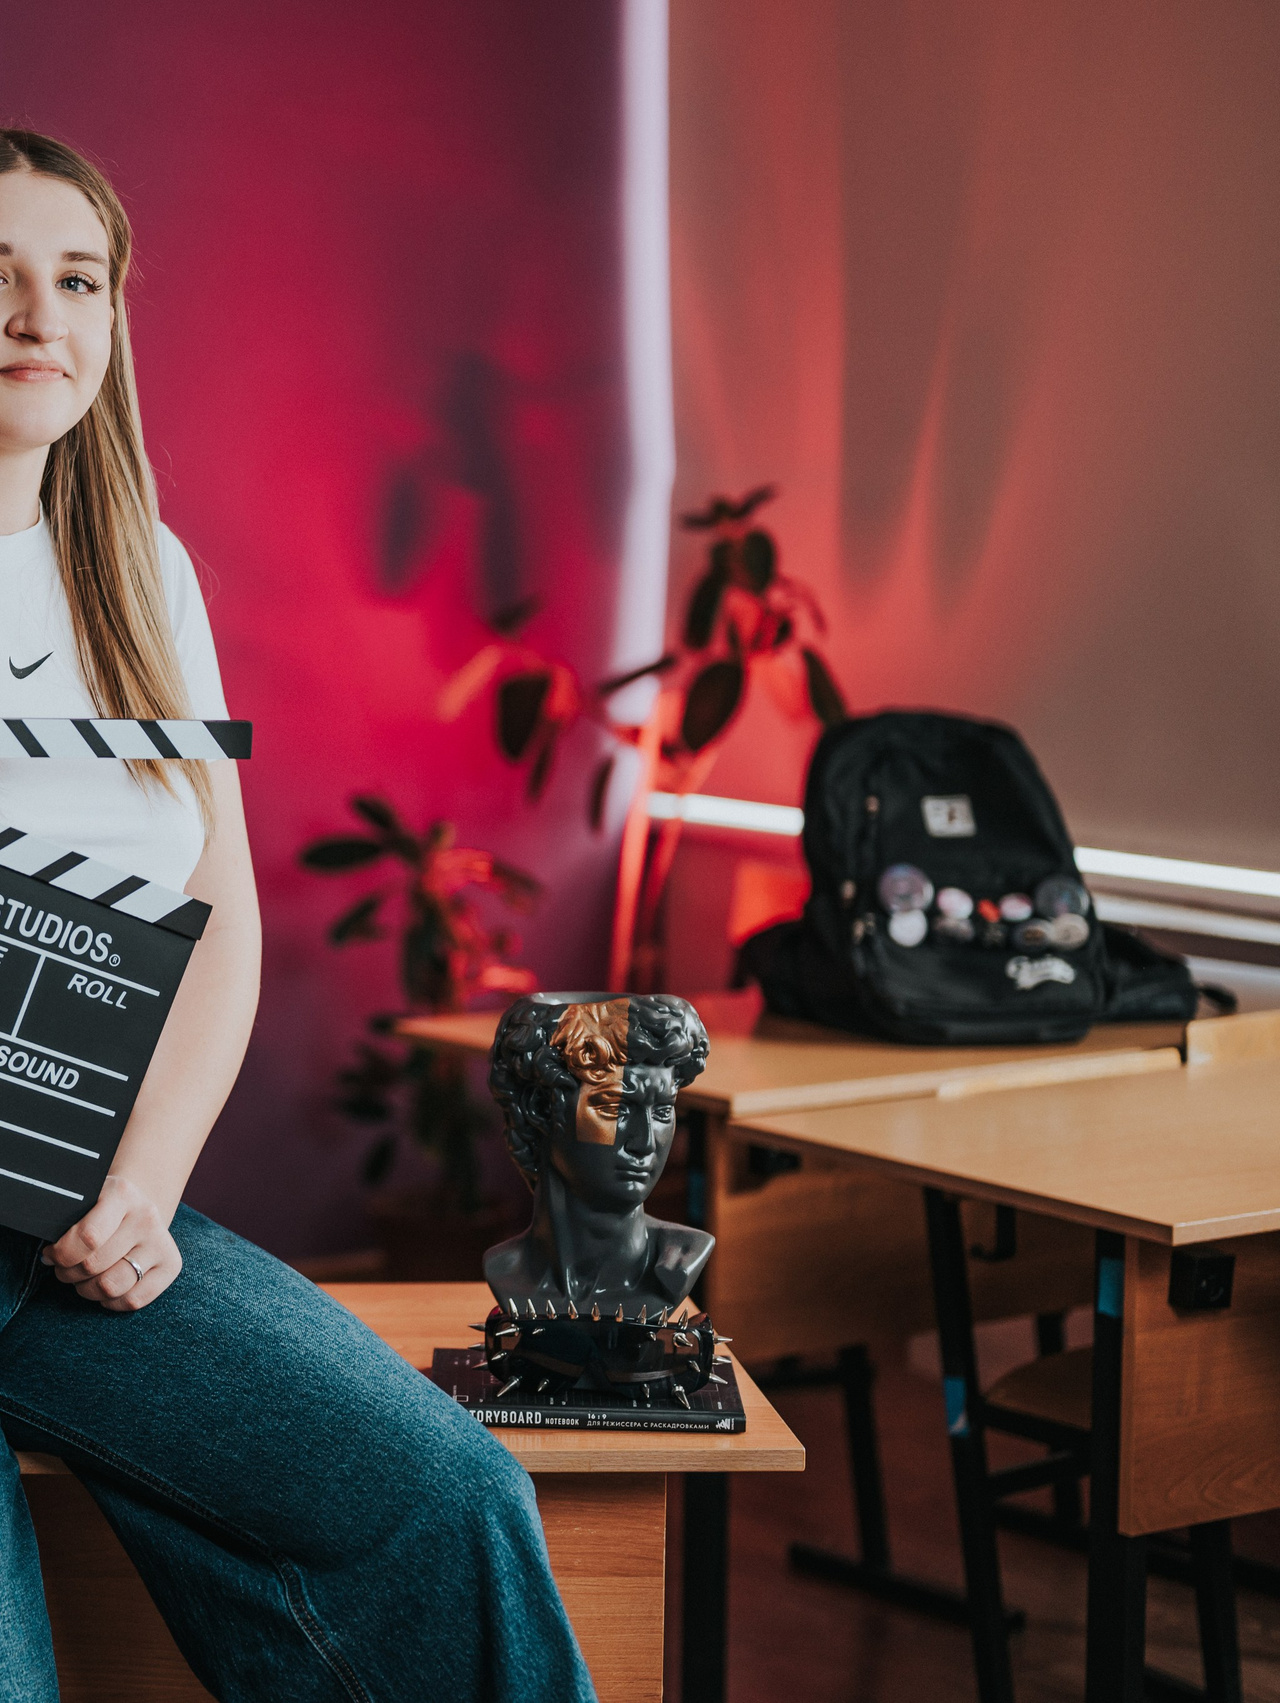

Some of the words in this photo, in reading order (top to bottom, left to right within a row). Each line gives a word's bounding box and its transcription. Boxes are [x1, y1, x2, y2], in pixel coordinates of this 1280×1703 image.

[67, 974, 127, 1010] ROLL
[469, 1409, 542, 1425] TORYBOARD
[545, 1417, 580, 1426] NOTEBOOK
[602, 1420, 642, 1428] РЕЖИССЕРА
[650, 1422, 710, 1430] РАСКАДРОВКАМИ
